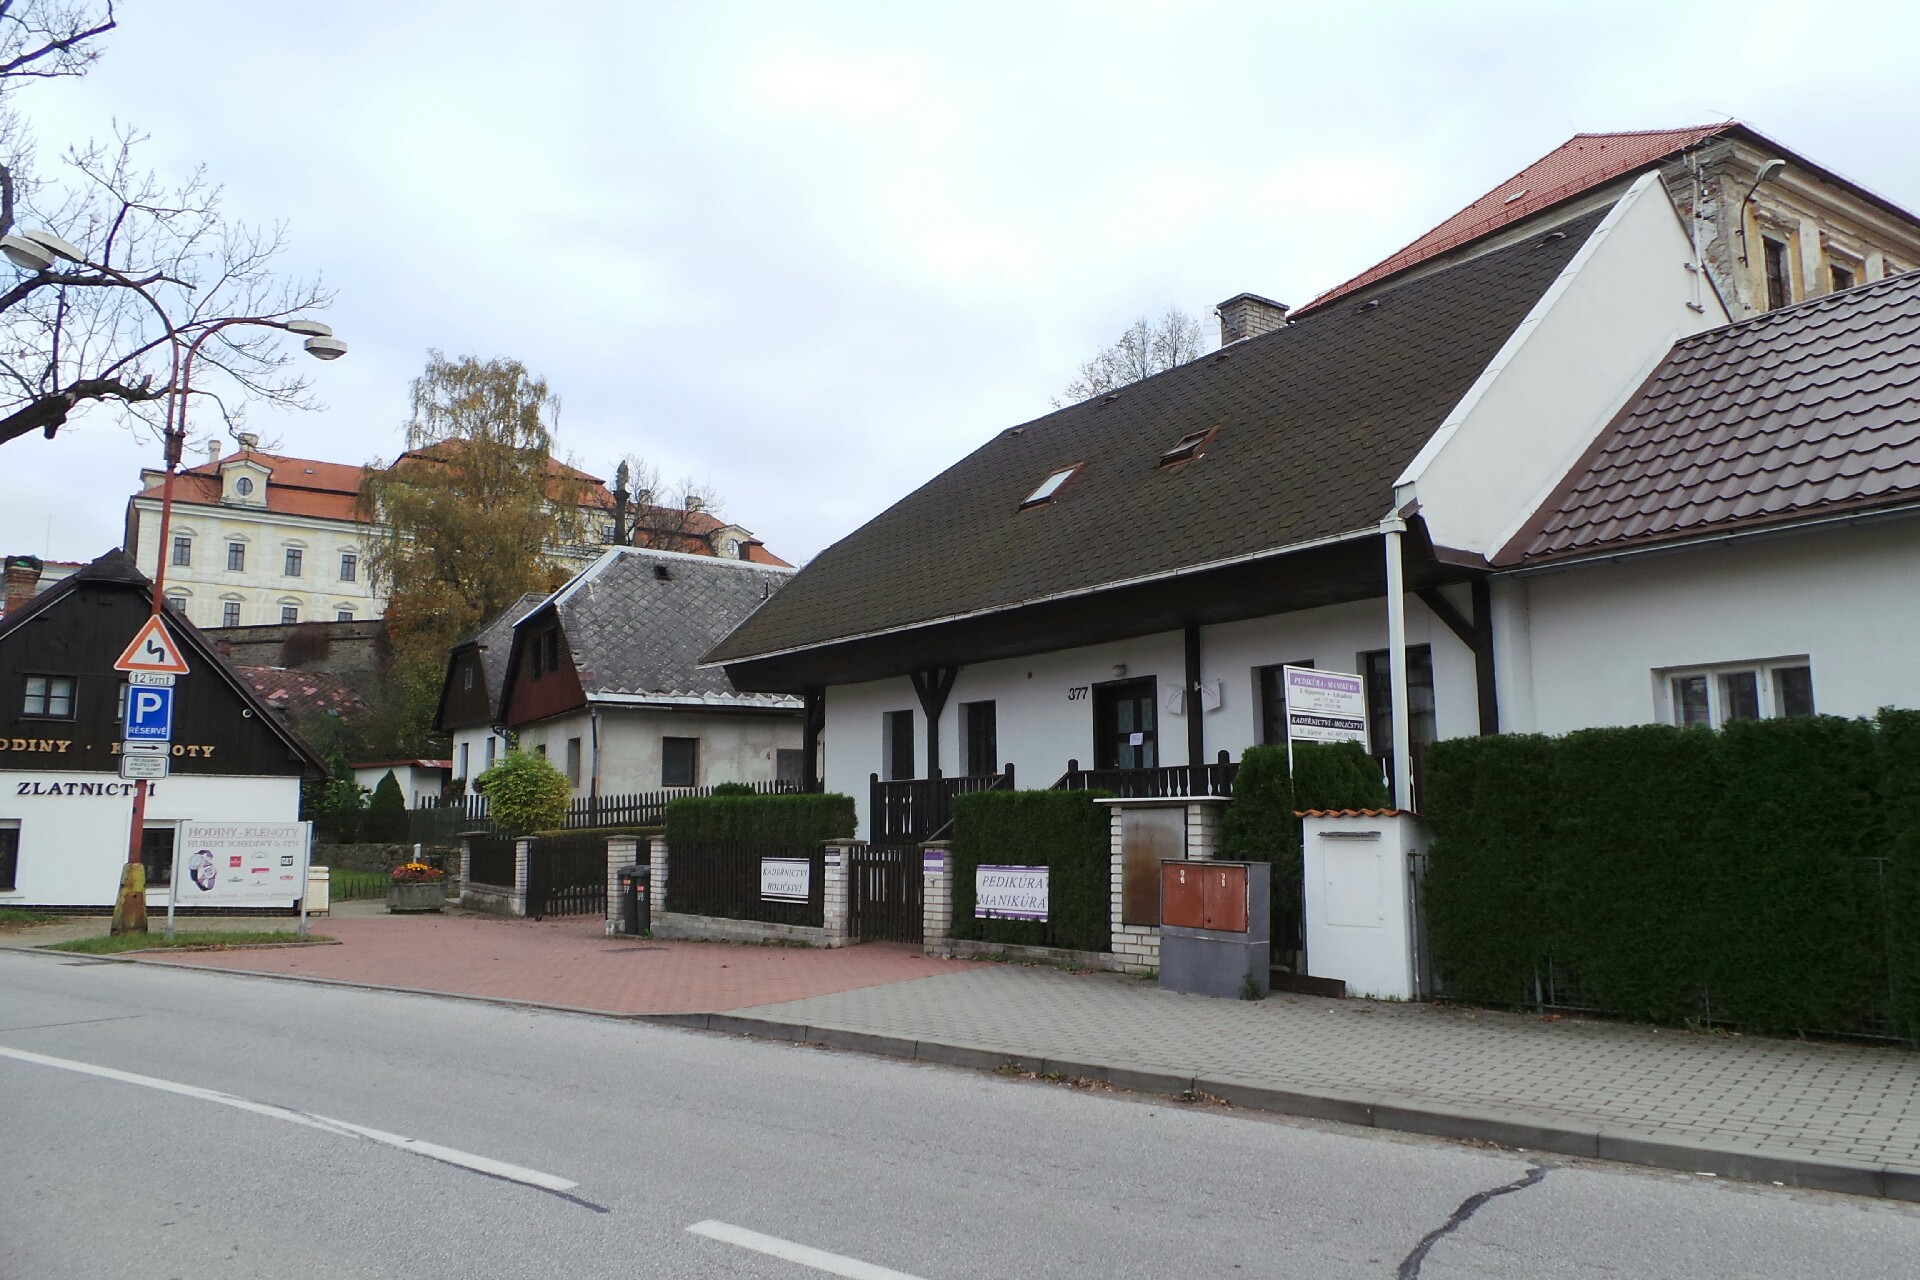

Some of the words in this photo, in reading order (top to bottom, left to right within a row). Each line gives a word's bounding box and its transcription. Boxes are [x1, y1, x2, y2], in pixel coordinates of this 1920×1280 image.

[140, 674, 146, 683] 2
[149, 675, 164, 684] km
[1068, 686, 1088, 700] 377
[136, 692, 162, 723] P
[1291, 716, 1331, 727] KADEŘNICTVÍ
[1334, 720, 1363, 730] HOLIČSTVÍ
[128, 726, 167, 735] RÉSERVÉ
[0, 738, 72, 753] ODINY
[110, 742, 215, 758] KOTY
[17, 782, 156, 797] ZLATNICTÍ
[188, 827, 237, 837] HODINY
[244, 828, 299, 837] KLENOTY
[187, 840, 225, 848] HUBERT
[982, 874, 1044, 889] PEDIKÚRA
[979, 893, 1046, 909] MANIKÚRA
